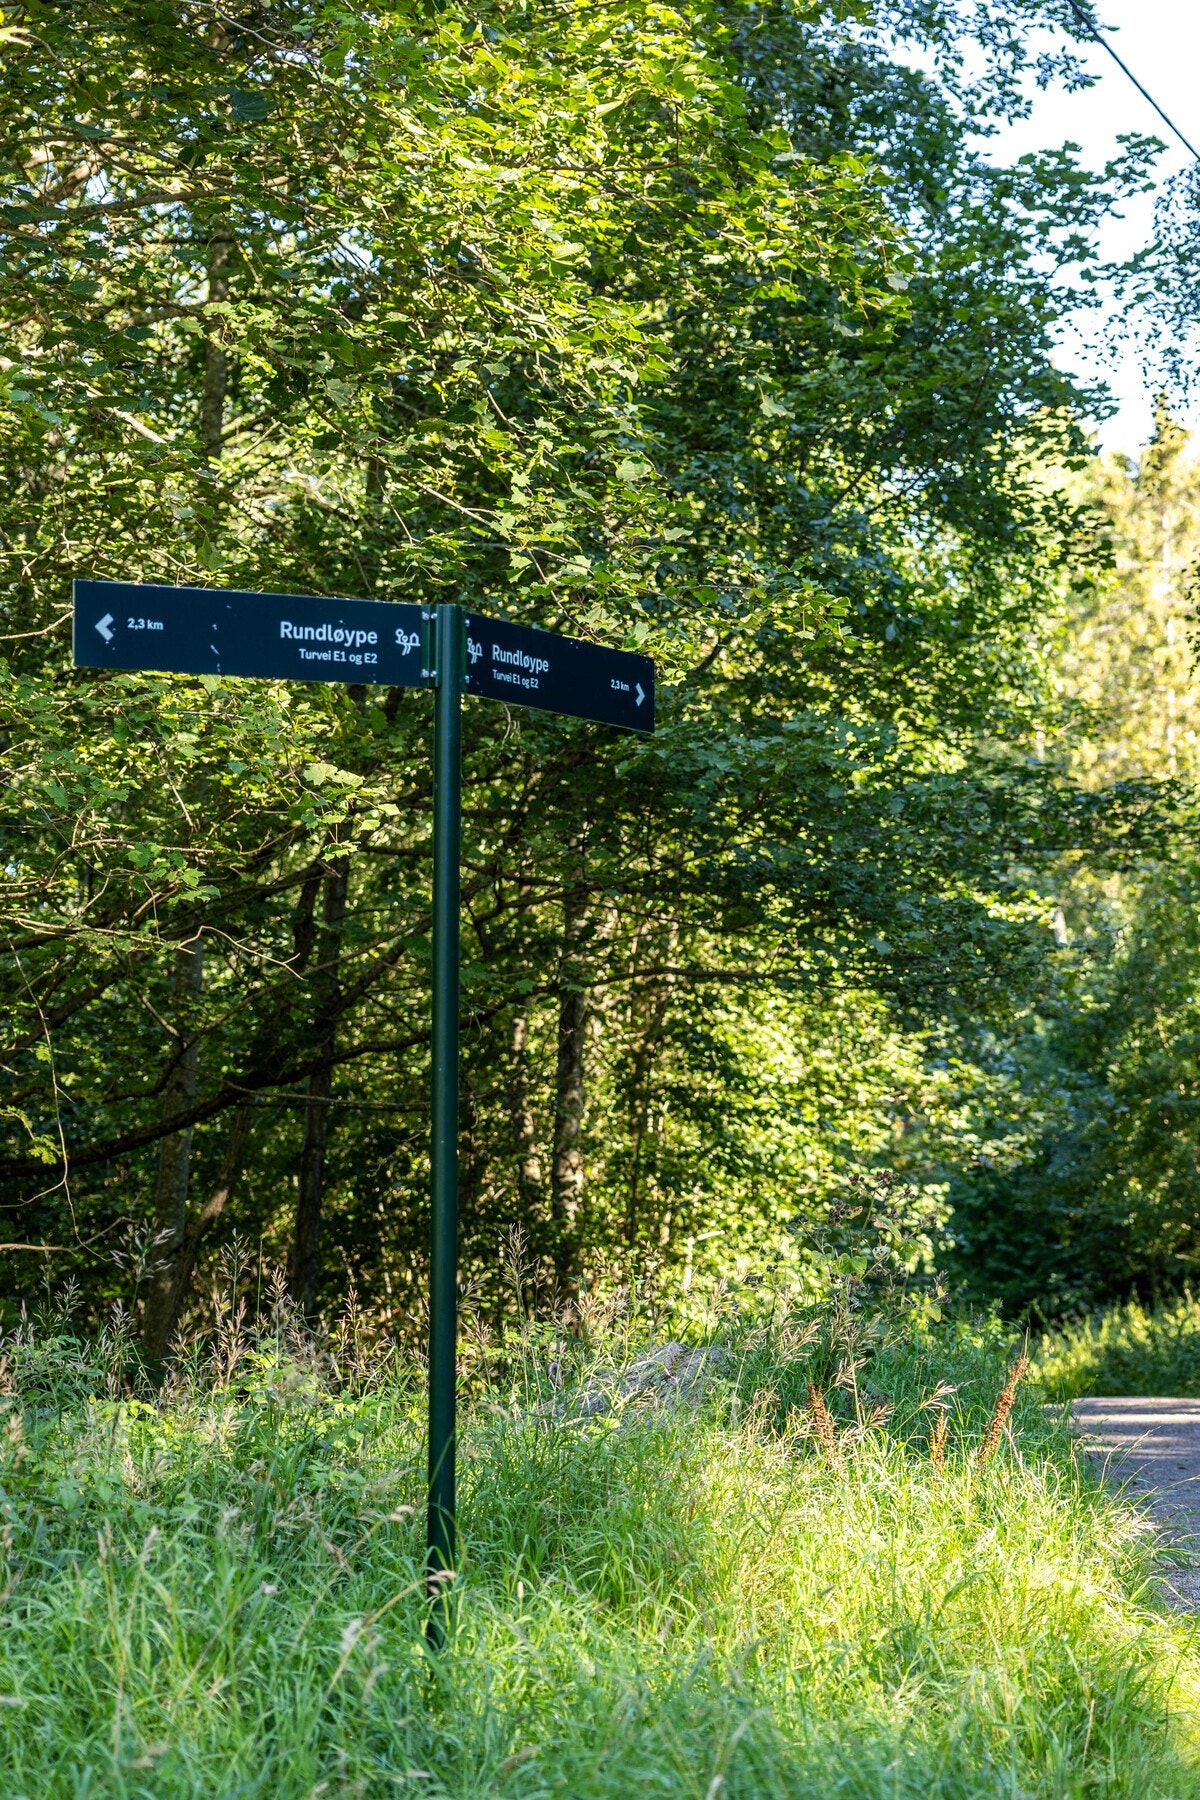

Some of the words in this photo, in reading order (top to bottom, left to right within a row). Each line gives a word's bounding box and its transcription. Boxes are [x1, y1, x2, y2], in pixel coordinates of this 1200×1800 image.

[127, 617, 146, 631] 2,3
[147, 618, 164, 631] km
[280, 621, 378, 648] Rundløype
[299, 648, 332, 661] Turvei
[333, 650, 347, 662] E1
[348, 653, 363, 666] og
[364, 652, 378, 664] E2
[492, 643, 549, 675] Rundløype
[492, 668, 512, 683] Turvei
[512, 673, 521, 685] E1
[521, 678, 530, 689] og
[530, 677, 539, 689] E2
[610, 678, 620, 691] 2,3
[620, 681, 630, 692] km
